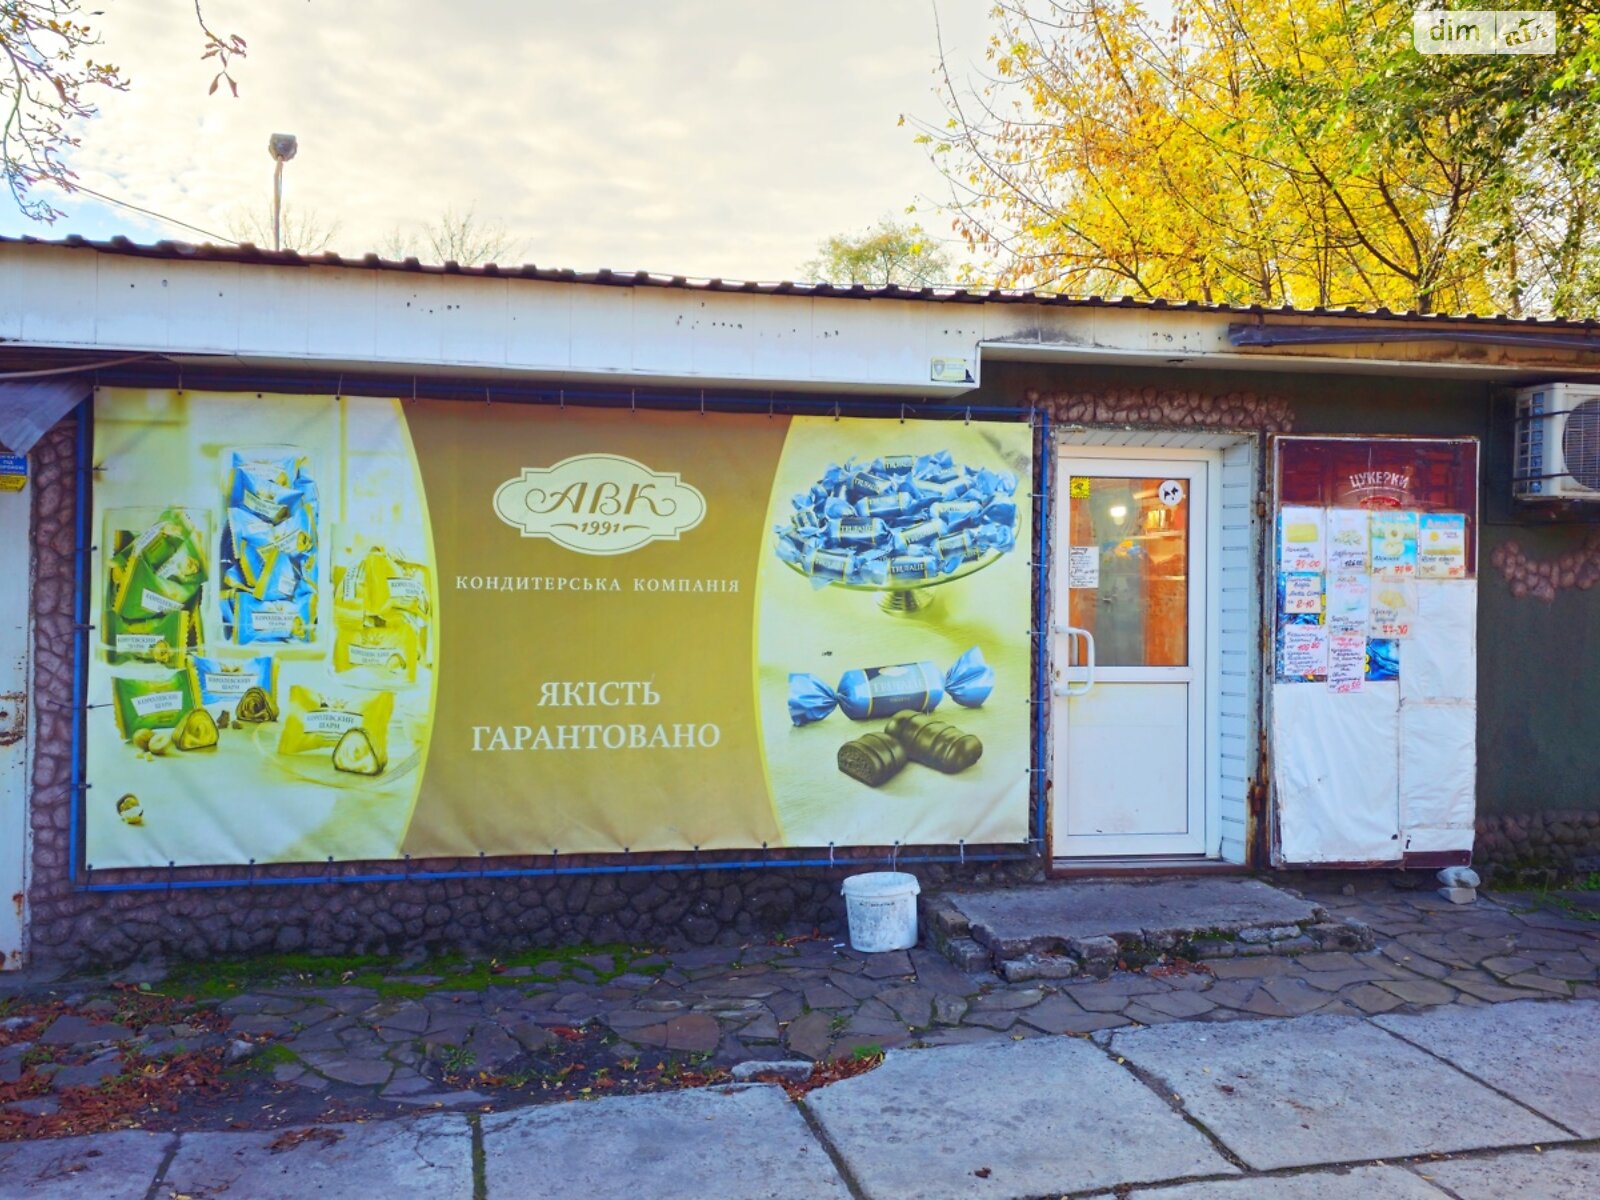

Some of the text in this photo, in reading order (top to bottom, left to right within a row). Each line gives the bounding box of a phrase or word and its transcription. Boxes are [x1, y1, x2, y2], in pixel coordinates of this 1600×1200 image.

[525, 481, 677, 516] АВК
[580, 520, 621, 536] 1991
[456, 575, 740, 592] КОНДИТЕРСЬКА КОМПАНІЯ
[537, 681, 661, 708] ЯКІСТЬ
[471, 722, 721, 752] ГАРАНТОВАНО
